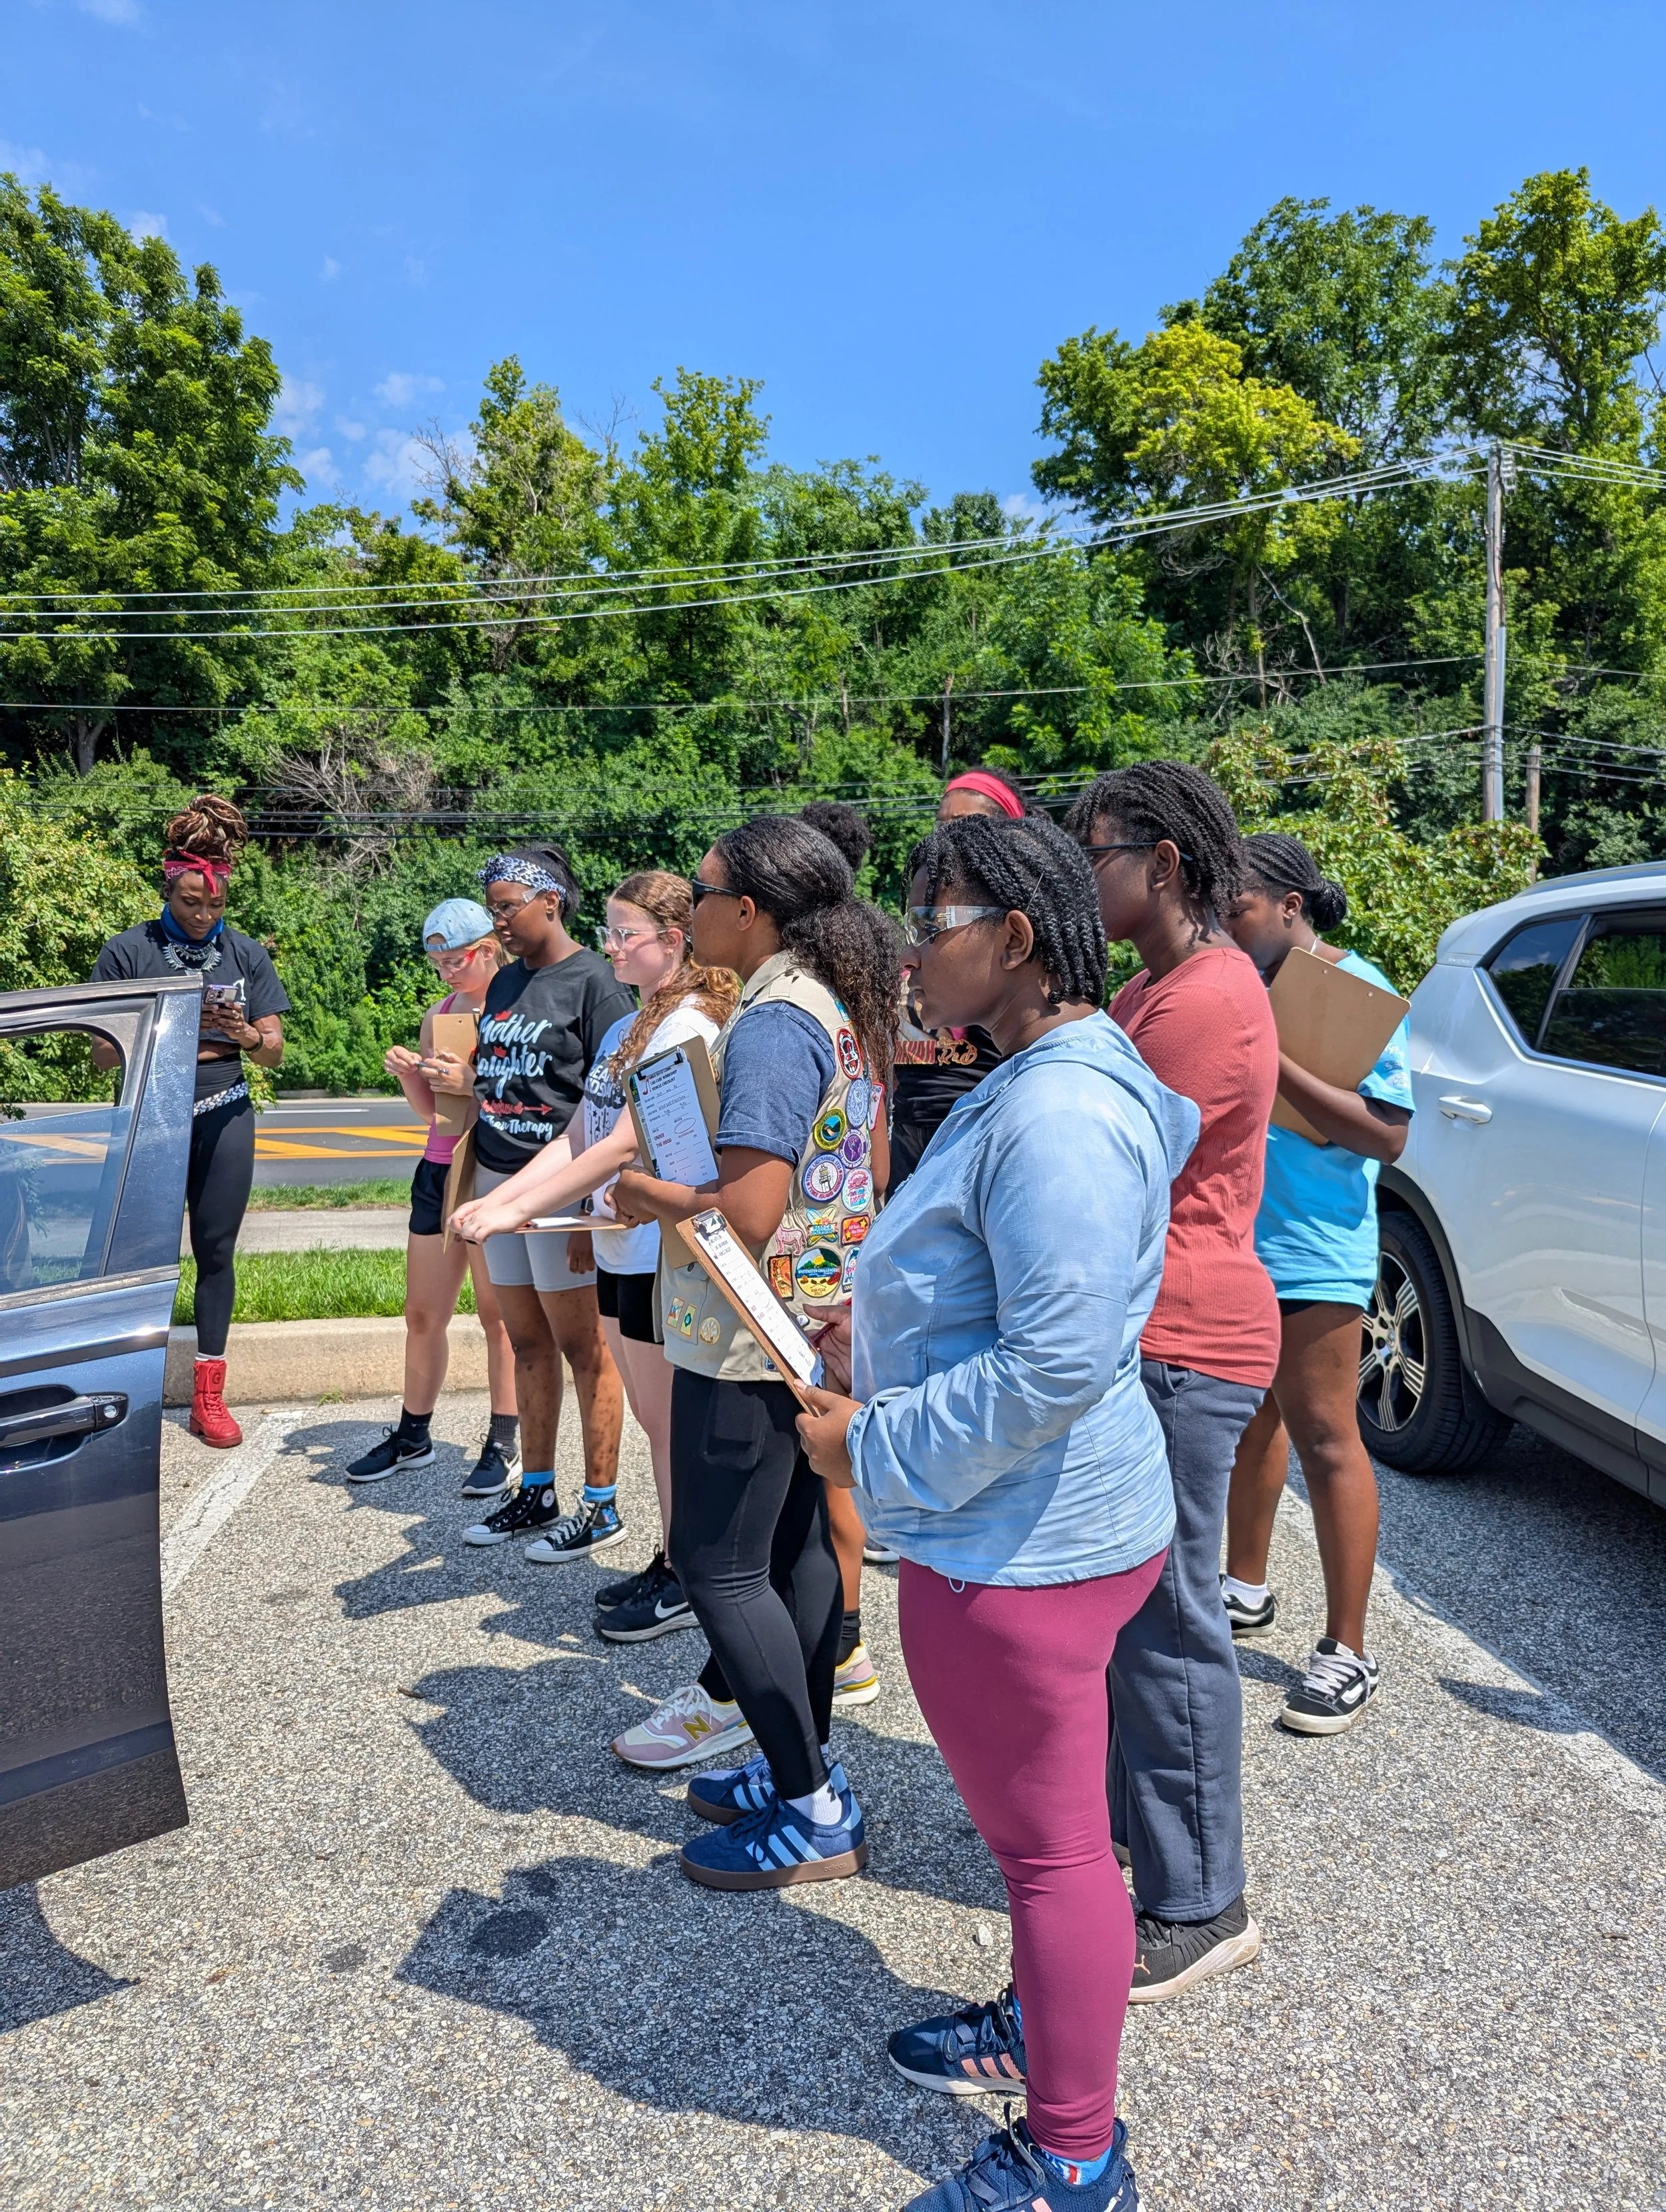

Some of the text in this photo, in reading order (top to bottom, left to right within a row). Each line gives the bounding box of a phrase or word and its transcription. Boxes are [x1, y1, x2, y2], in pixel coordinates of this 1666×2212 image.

[480, 1014, 552, 1047] Mother
[476, 1044, 553, 1099] aughter
[508, 1119, 553, 1142] Therapy
[680, 1714, 713, 1742] N
[824, 1862, 847, 1872] adidas
